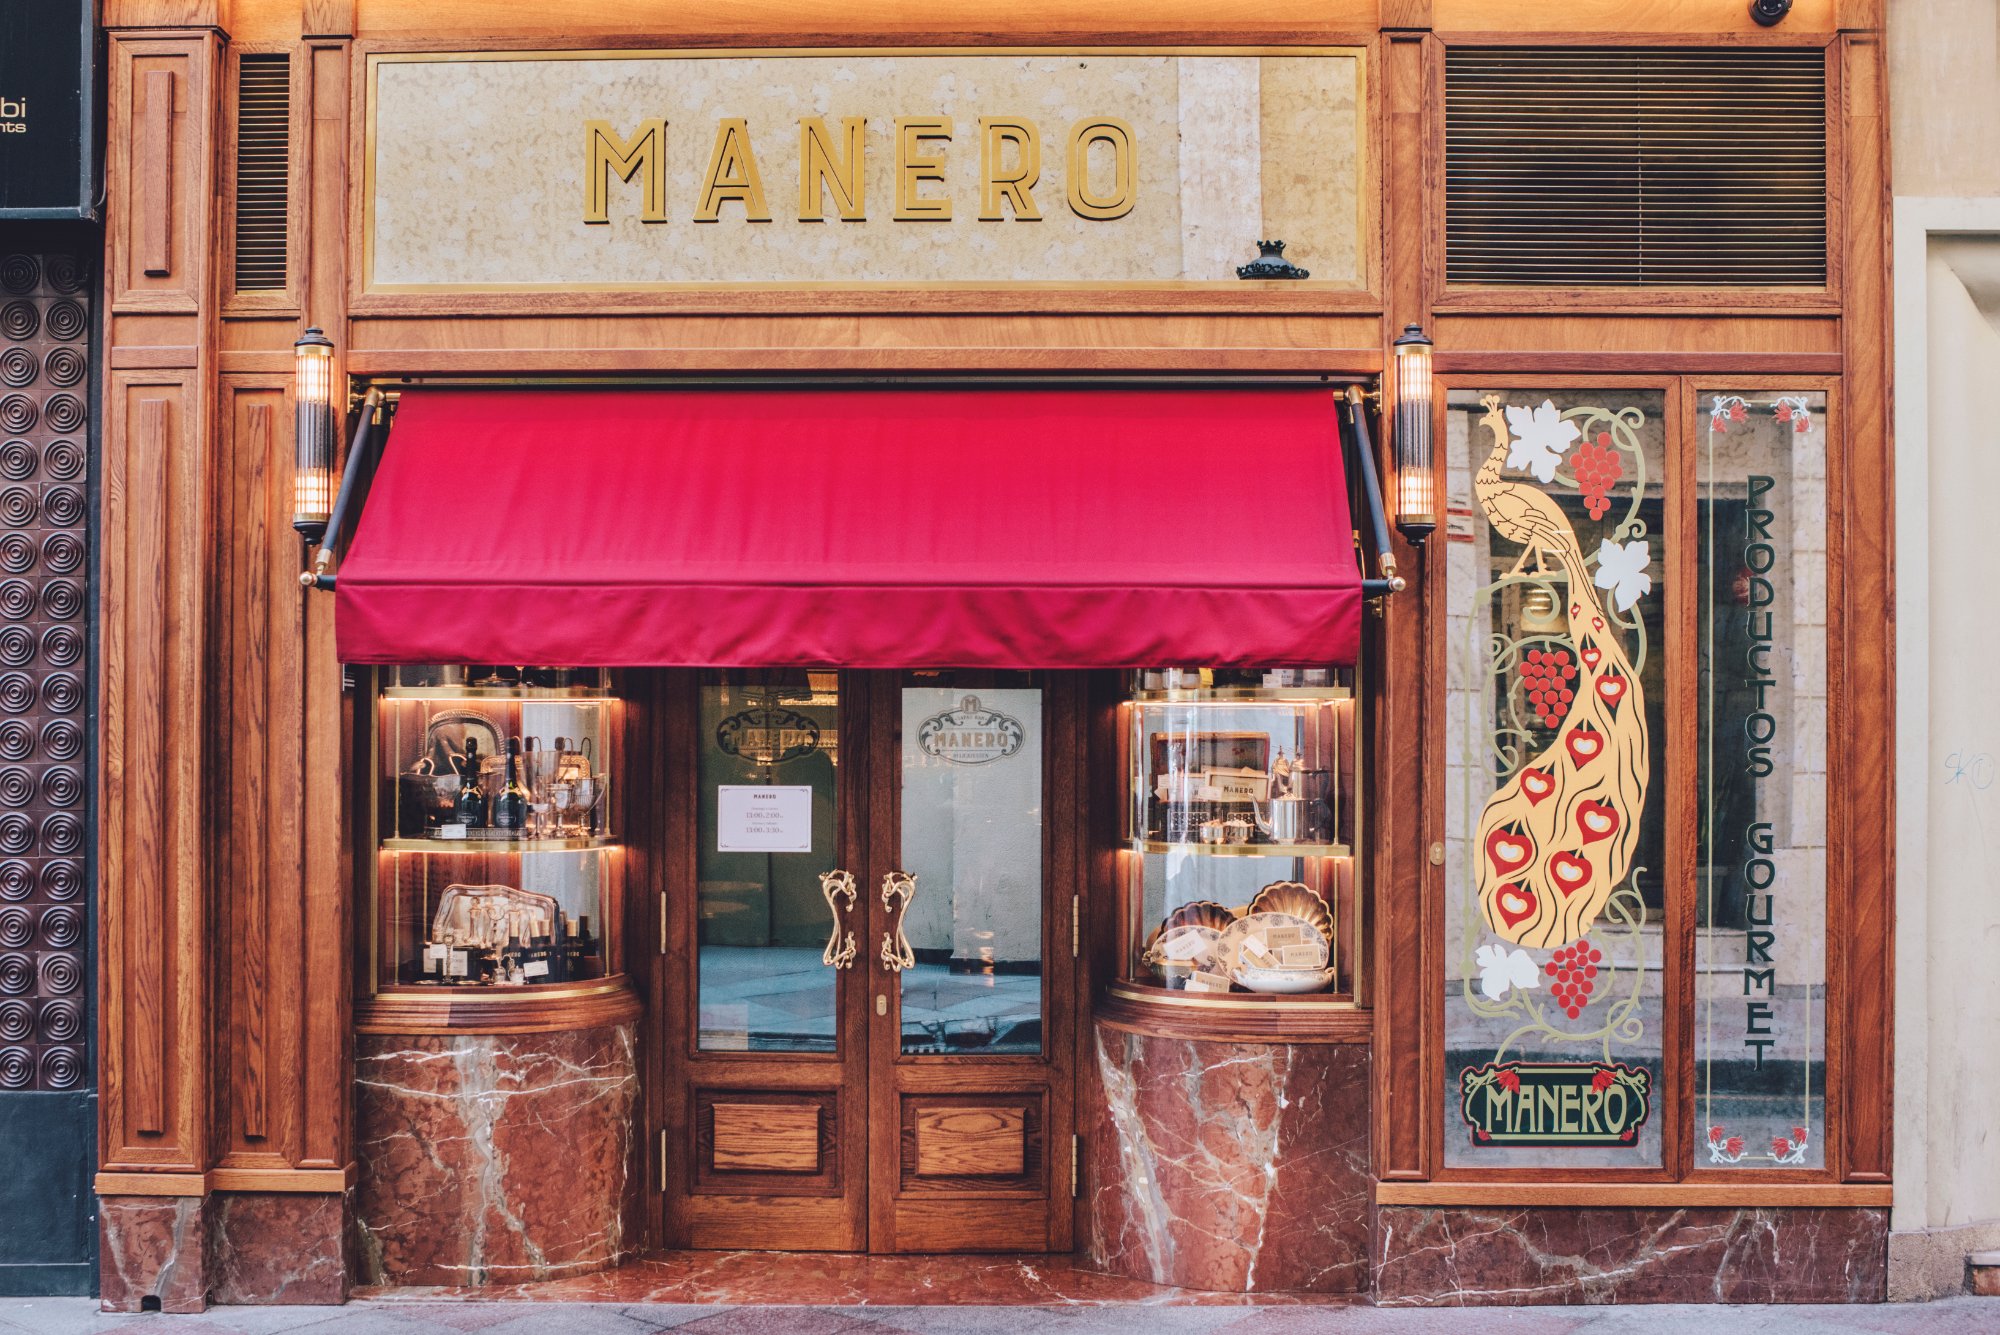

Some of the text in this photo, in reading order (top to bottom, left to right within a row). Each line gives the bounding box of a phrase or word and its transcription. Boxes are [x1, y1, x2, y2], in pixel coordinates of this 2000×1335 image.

[0, 97, 26, 118] bi
[584, 116, 1137, 224] MANERO
[933, 732, 1008, 748] MANERO
[1223, 784, 1254, 794] MANERO
[1743, 475, 1776, 1072] PRODUCTOS GOURMET
[1484, 1084, 1627, 1134] MANERO
